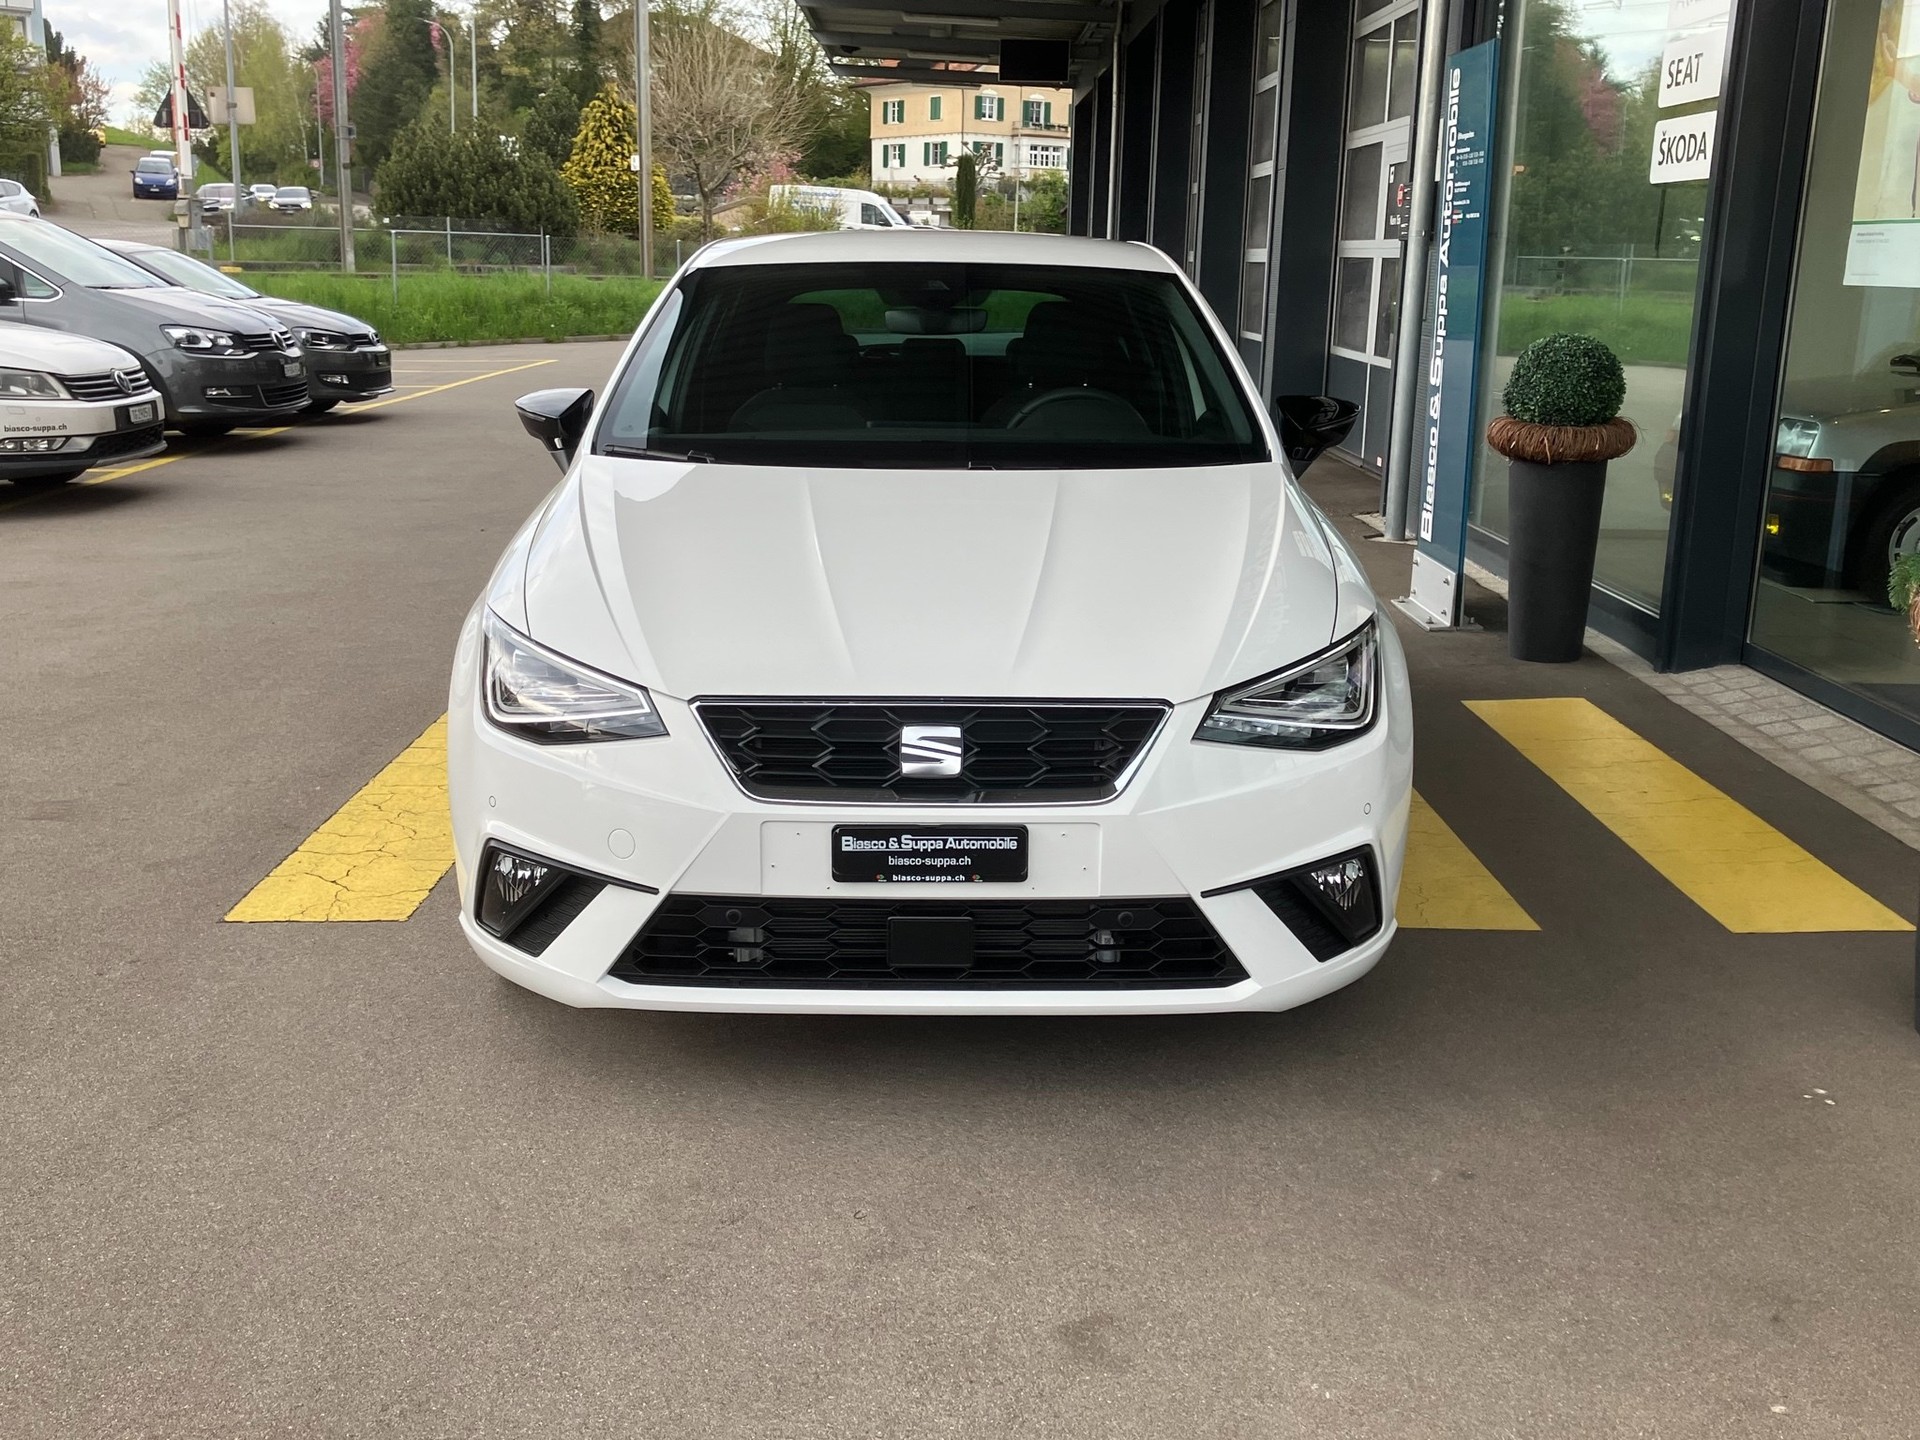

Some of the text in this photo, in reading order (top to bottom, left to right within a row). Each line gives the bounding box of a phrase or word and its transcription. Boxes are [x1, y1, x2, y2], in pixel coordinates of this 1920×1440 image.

[1666, 52, 1703, 90] SEAT
[1658, 130, 1707, 166] ŠKODA
[1439, 68, 1461, 268] Automobile
[1430, 275, 1448, 387] Suppa
[1430, 392, 1441, 420] &
[3, 423, 68, 433] biasco-suppa.ch
[1421, 427, 1437, 543] Biasco
[841, 834, 1018, 851] Biasco & Suppa Automobile
[888, 855, 972, 868] biasco-suppa.ch
